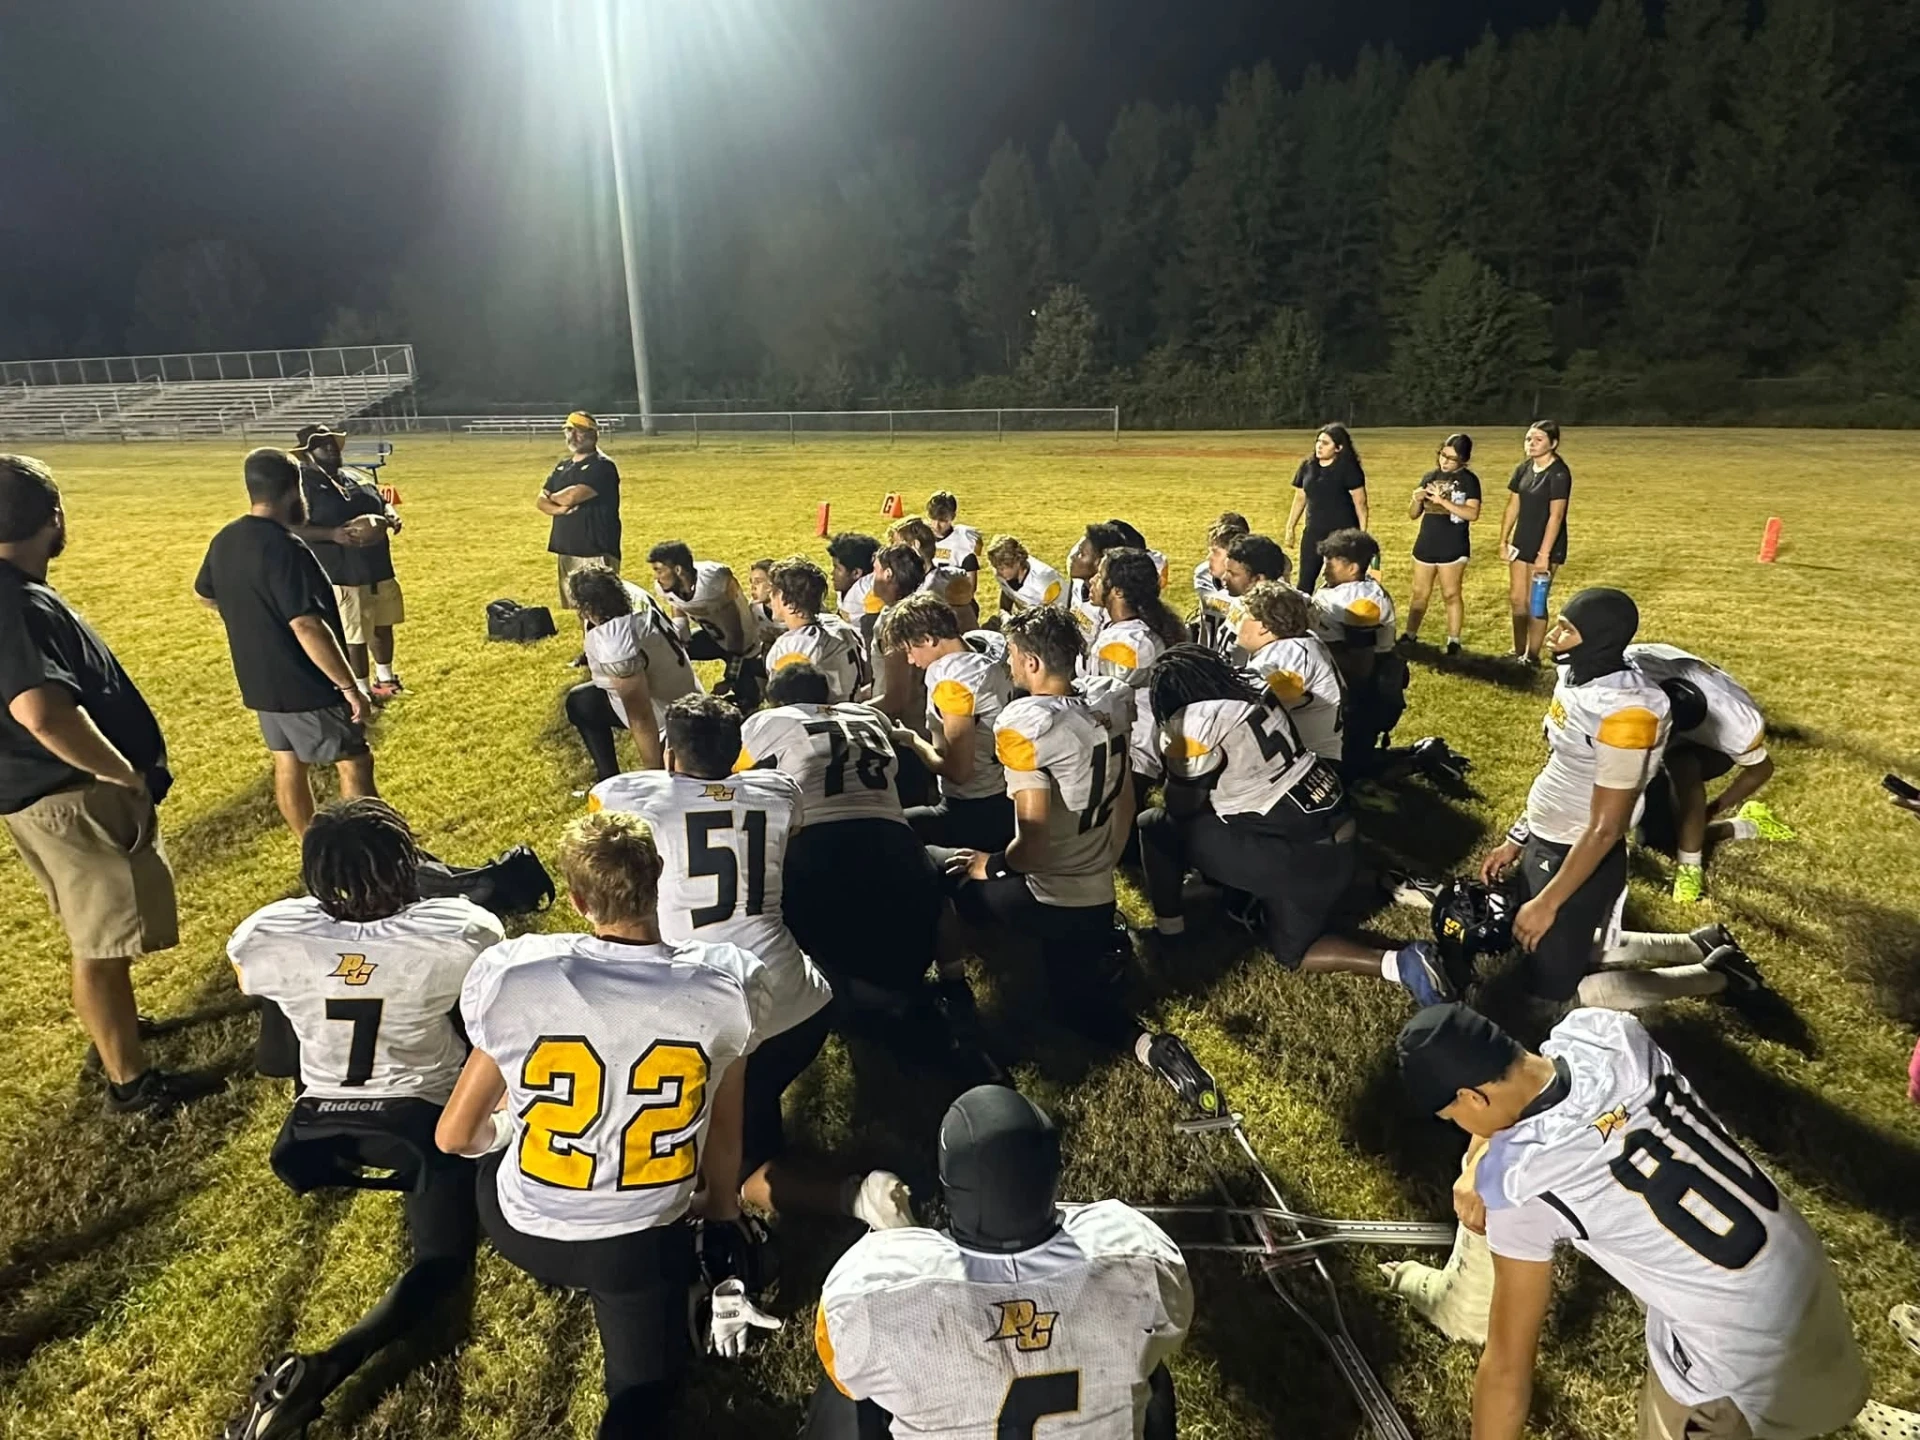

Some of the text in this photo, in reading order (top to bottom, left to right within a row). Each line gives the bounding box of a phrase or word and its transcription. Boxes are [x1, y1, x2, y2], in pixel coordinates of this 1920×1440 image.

[883, 496, 894, 514] G
[685, 809, 767, 930] 51
[325, 998, 384, 1087] 7
[317, 1101, 383, 1112] Riddell
[518, 1035, 712, 1191] 22
[1608, 1074, 1779, 1271] 80
